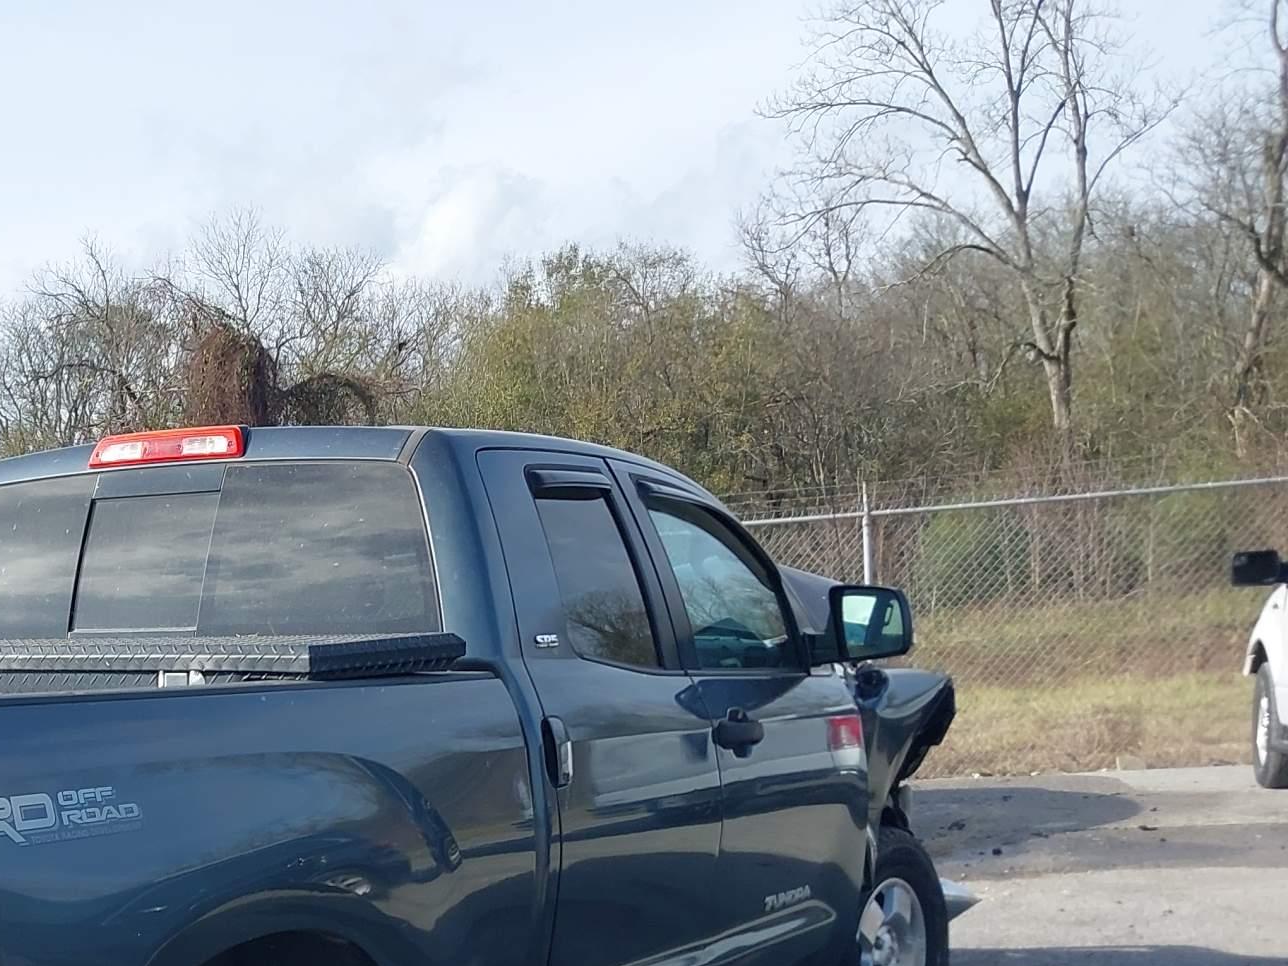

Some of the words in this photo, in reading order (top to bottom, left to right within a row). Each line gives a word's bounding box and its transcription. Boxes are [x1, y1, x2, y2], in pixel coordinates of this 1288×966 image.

[57, 786, 116, 807] OFF
[61, 803, 142, 827] ROAD
[764, 884, 811, 912] TUNDRA
